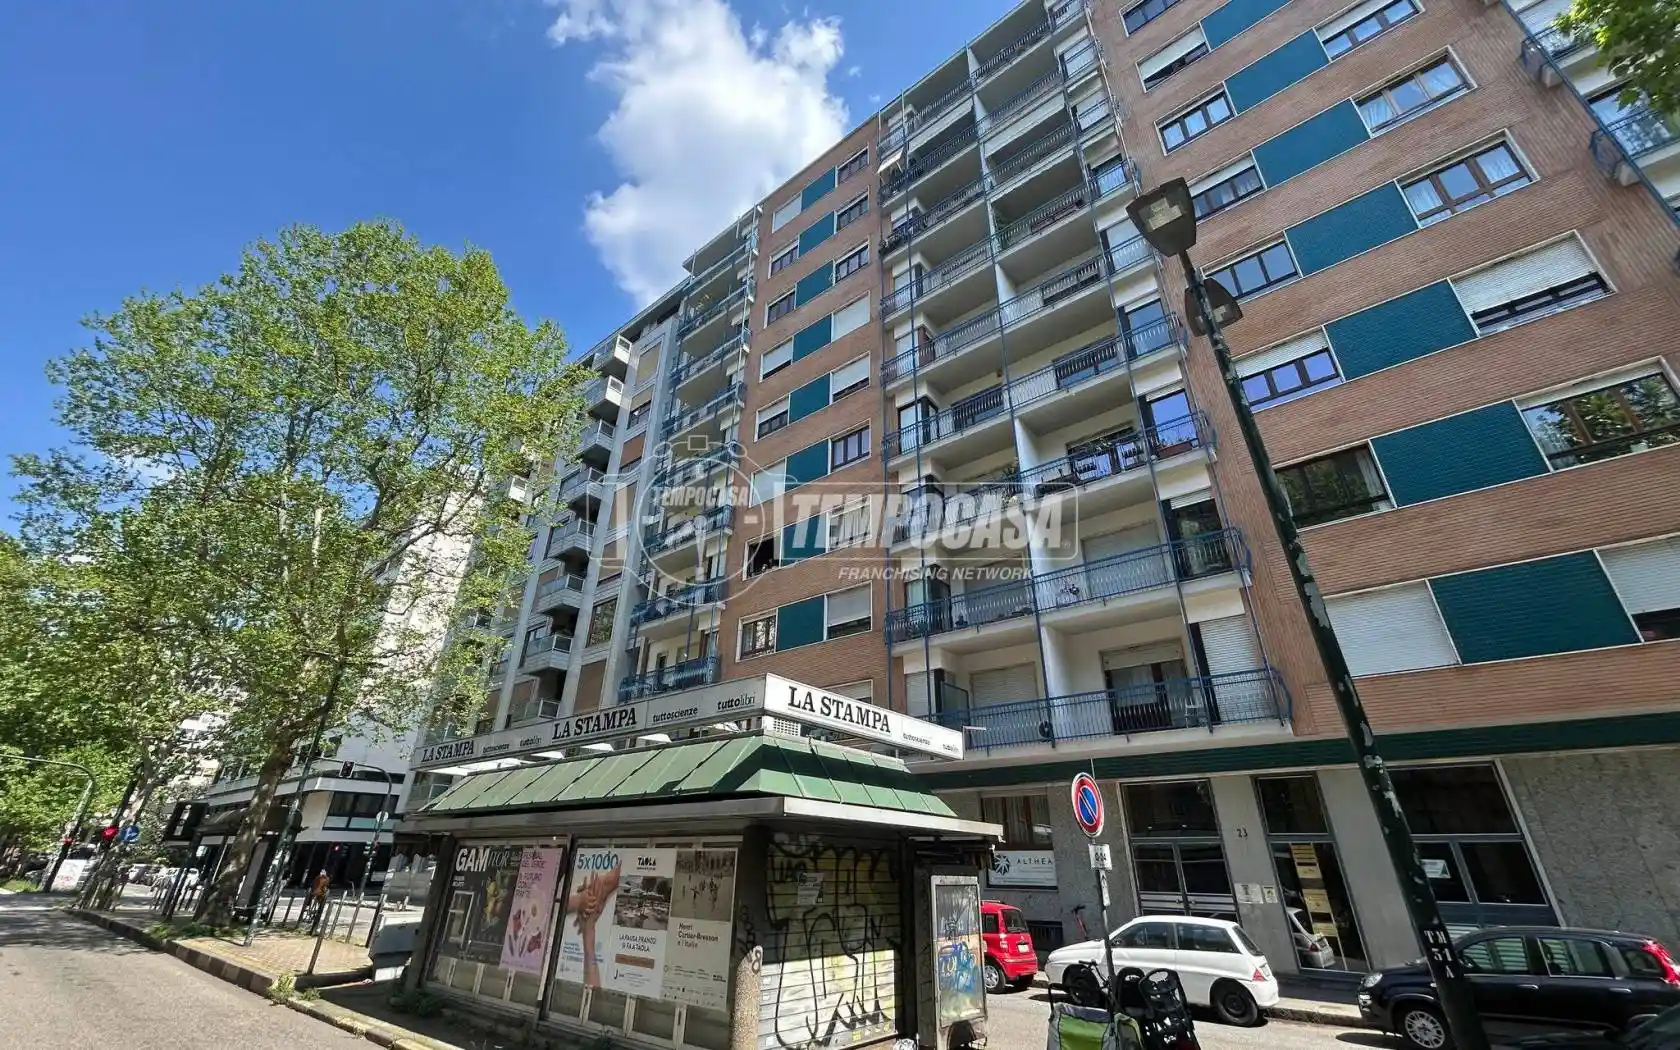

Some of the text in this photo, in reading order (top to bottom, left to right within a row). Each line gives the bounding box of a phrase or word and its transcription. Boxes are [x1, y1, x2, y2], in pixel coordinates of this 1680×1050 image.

[652, 706, 698, 723] tuttoscienze
[787, 685, 892, 734] LA STAMPA
[551, 707, 638, 741] LA STAMPA
[421, 740, 475, 763] LA STAMPA
[1236, 827, 1248, 839] 23
[455, 847, 491, 872] GAM
[577, 852, 619, 871] 5x1000
[1016, 856, 1053, 866] ALTHEA
[678, 923, 693, 931] Henri
[678, 931, 719, 942] Cartier-Bresson
